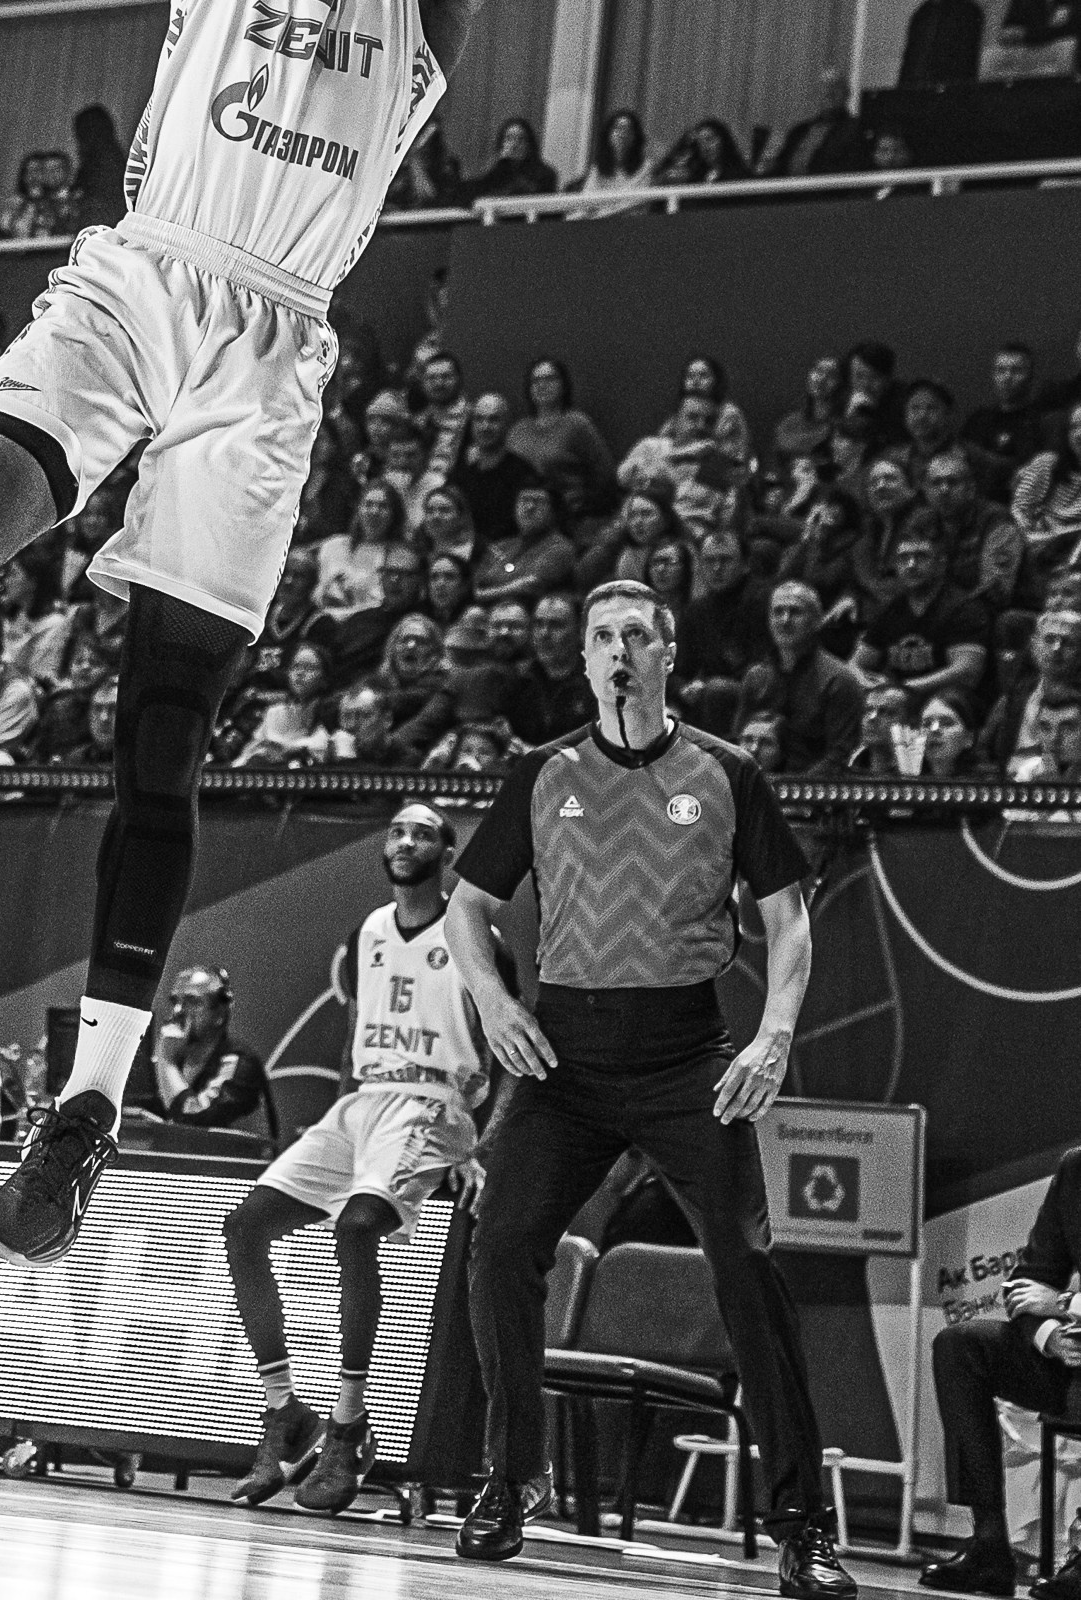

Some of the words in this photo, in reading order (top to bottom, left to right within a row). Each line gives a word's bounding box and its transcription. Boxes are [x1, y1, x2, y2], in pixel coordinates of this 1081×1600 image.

[244, 0, 384, 79] ZENIT
[251, 119, 360, 181] ГАЗПРОМ
[389, 975, 415, 1013] 15
[364, 1024, 440, 1056] ZENIT
[970, 1248, 1024, 1281] Бар
